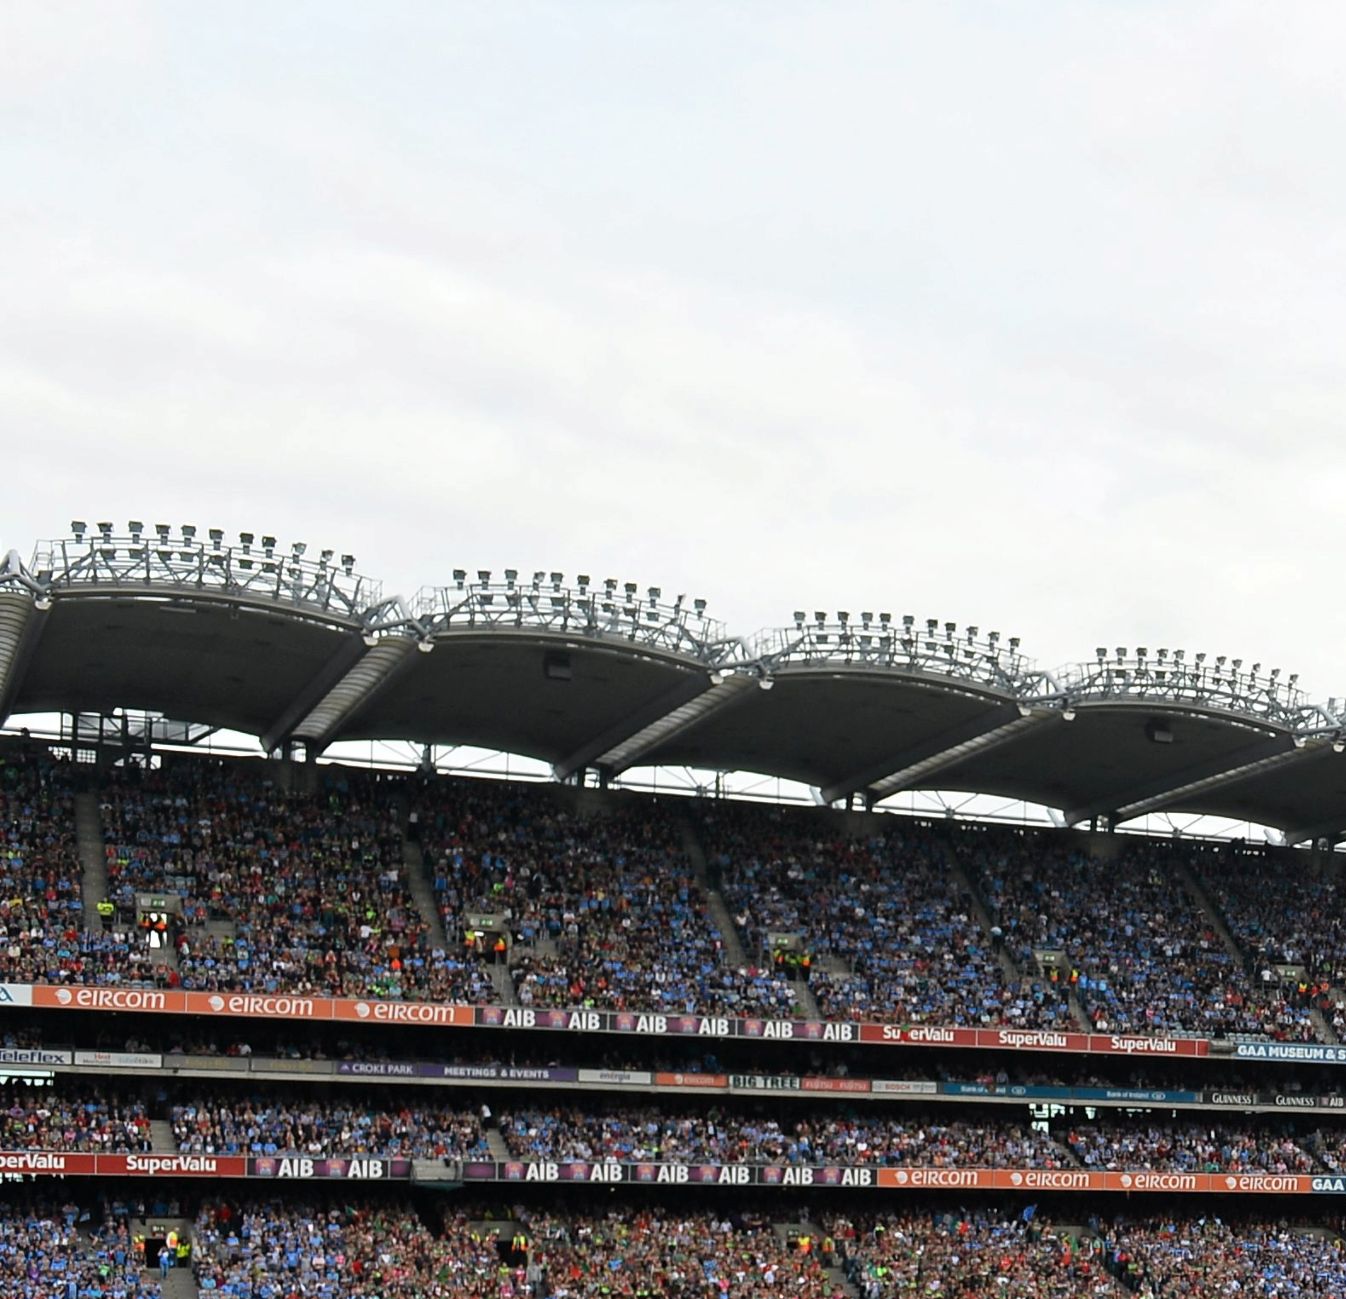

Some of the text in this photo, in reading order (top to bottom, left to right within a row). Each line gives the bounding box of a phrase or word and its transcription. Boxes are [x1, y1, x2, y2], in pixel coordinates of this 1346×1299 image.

[77, 990, 165, 1010] eircom
[229, 996, 313, 1016] eircom
[374, 1002, 454, 1023] eircom
[504, 1009, 536, 1027] AIB
[569, 1012, 601, 1031] AIB
[636, 1016, 668, 1033] AIB
[699, 1018, 729, 1035] AIB
[764, 1021, 793, 1038] AIB
[823, 1024, 852, 1041] AIB
[883, 1024, 954, 1043] SuerValu
[999, 1031, 1067, 1049] SuperValu
[1112, 1036, 1176, 1054] SuperValu
[1237, 1046, 1266, 1058] GAA
[1269, 1047, 1325, 1060] MUSEUM
[1325, 1049, 1336, 1059] &
[352, 1064, 413, 1076] CROKE PARK
[444, 1067, 496, 1078] MEETINGS
[510, 1069, 550, 1080] EVENTS
[732, 1075, 799, 1090] BIG TREE
[1212, 1092, 1252, 1104] GUINNESS
[1276, 1095, 1314, 1107] GUINNESS
[127, 1156, 216, 1174] SuperValu
[278, 1159, 314, 1177] AIB
[348, 1161, 383, 1178] AIB
[526, 1163, 559, 1180] AIB
[590, 1164, 623, 1182] AIB
[657, 1166, 690, 1183] AIB
[719, 1167, 750, 1184] AIB
[783, 1168, 813, 1185] AIB
[841, 1169, 872, 1186] AIB
[911, 1171, 977, 1186] eircom
[1025, 1173, 1089, 1188] eircom
[1135, 1175, 1196, 1190] eircom
[1240, 1177, 1298, 1192] eircom
[1312, 1180, 1346, 1192] GAA
